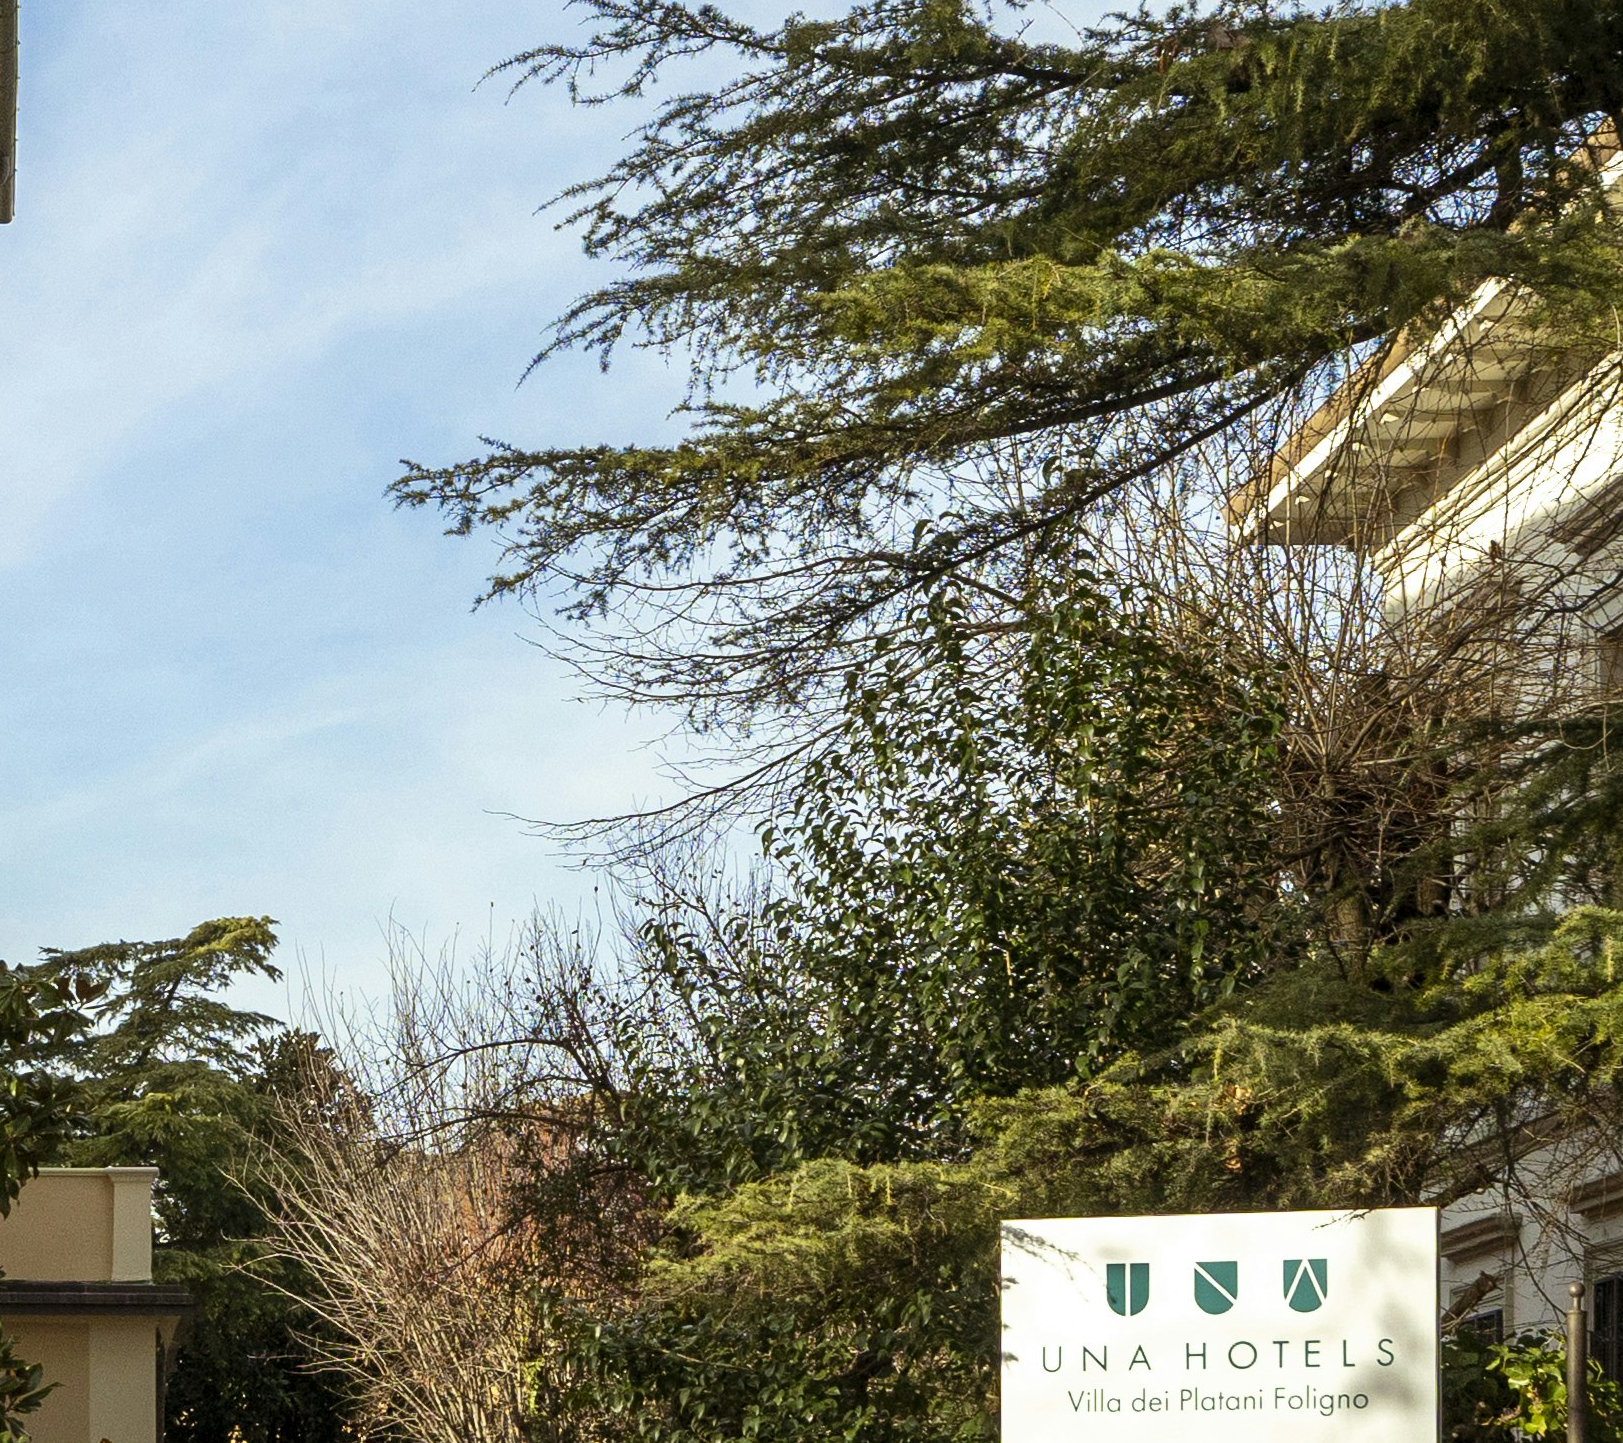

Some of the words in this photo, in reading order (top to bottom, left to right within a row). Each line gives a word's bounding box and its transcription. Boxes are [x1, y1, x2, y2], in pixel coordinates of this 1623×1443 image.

[1041, 1344, 1153, 1373] UNA
[1185, 1338, 1395, 1370] HOTELS
[1067, 1388, 1122, 1413] Villa
[1131, 1387, 1169, 1413] dei
[1180, 1386, 1264, 1412] Platani
[1274, 1384, 1370, 1417] Foligno
